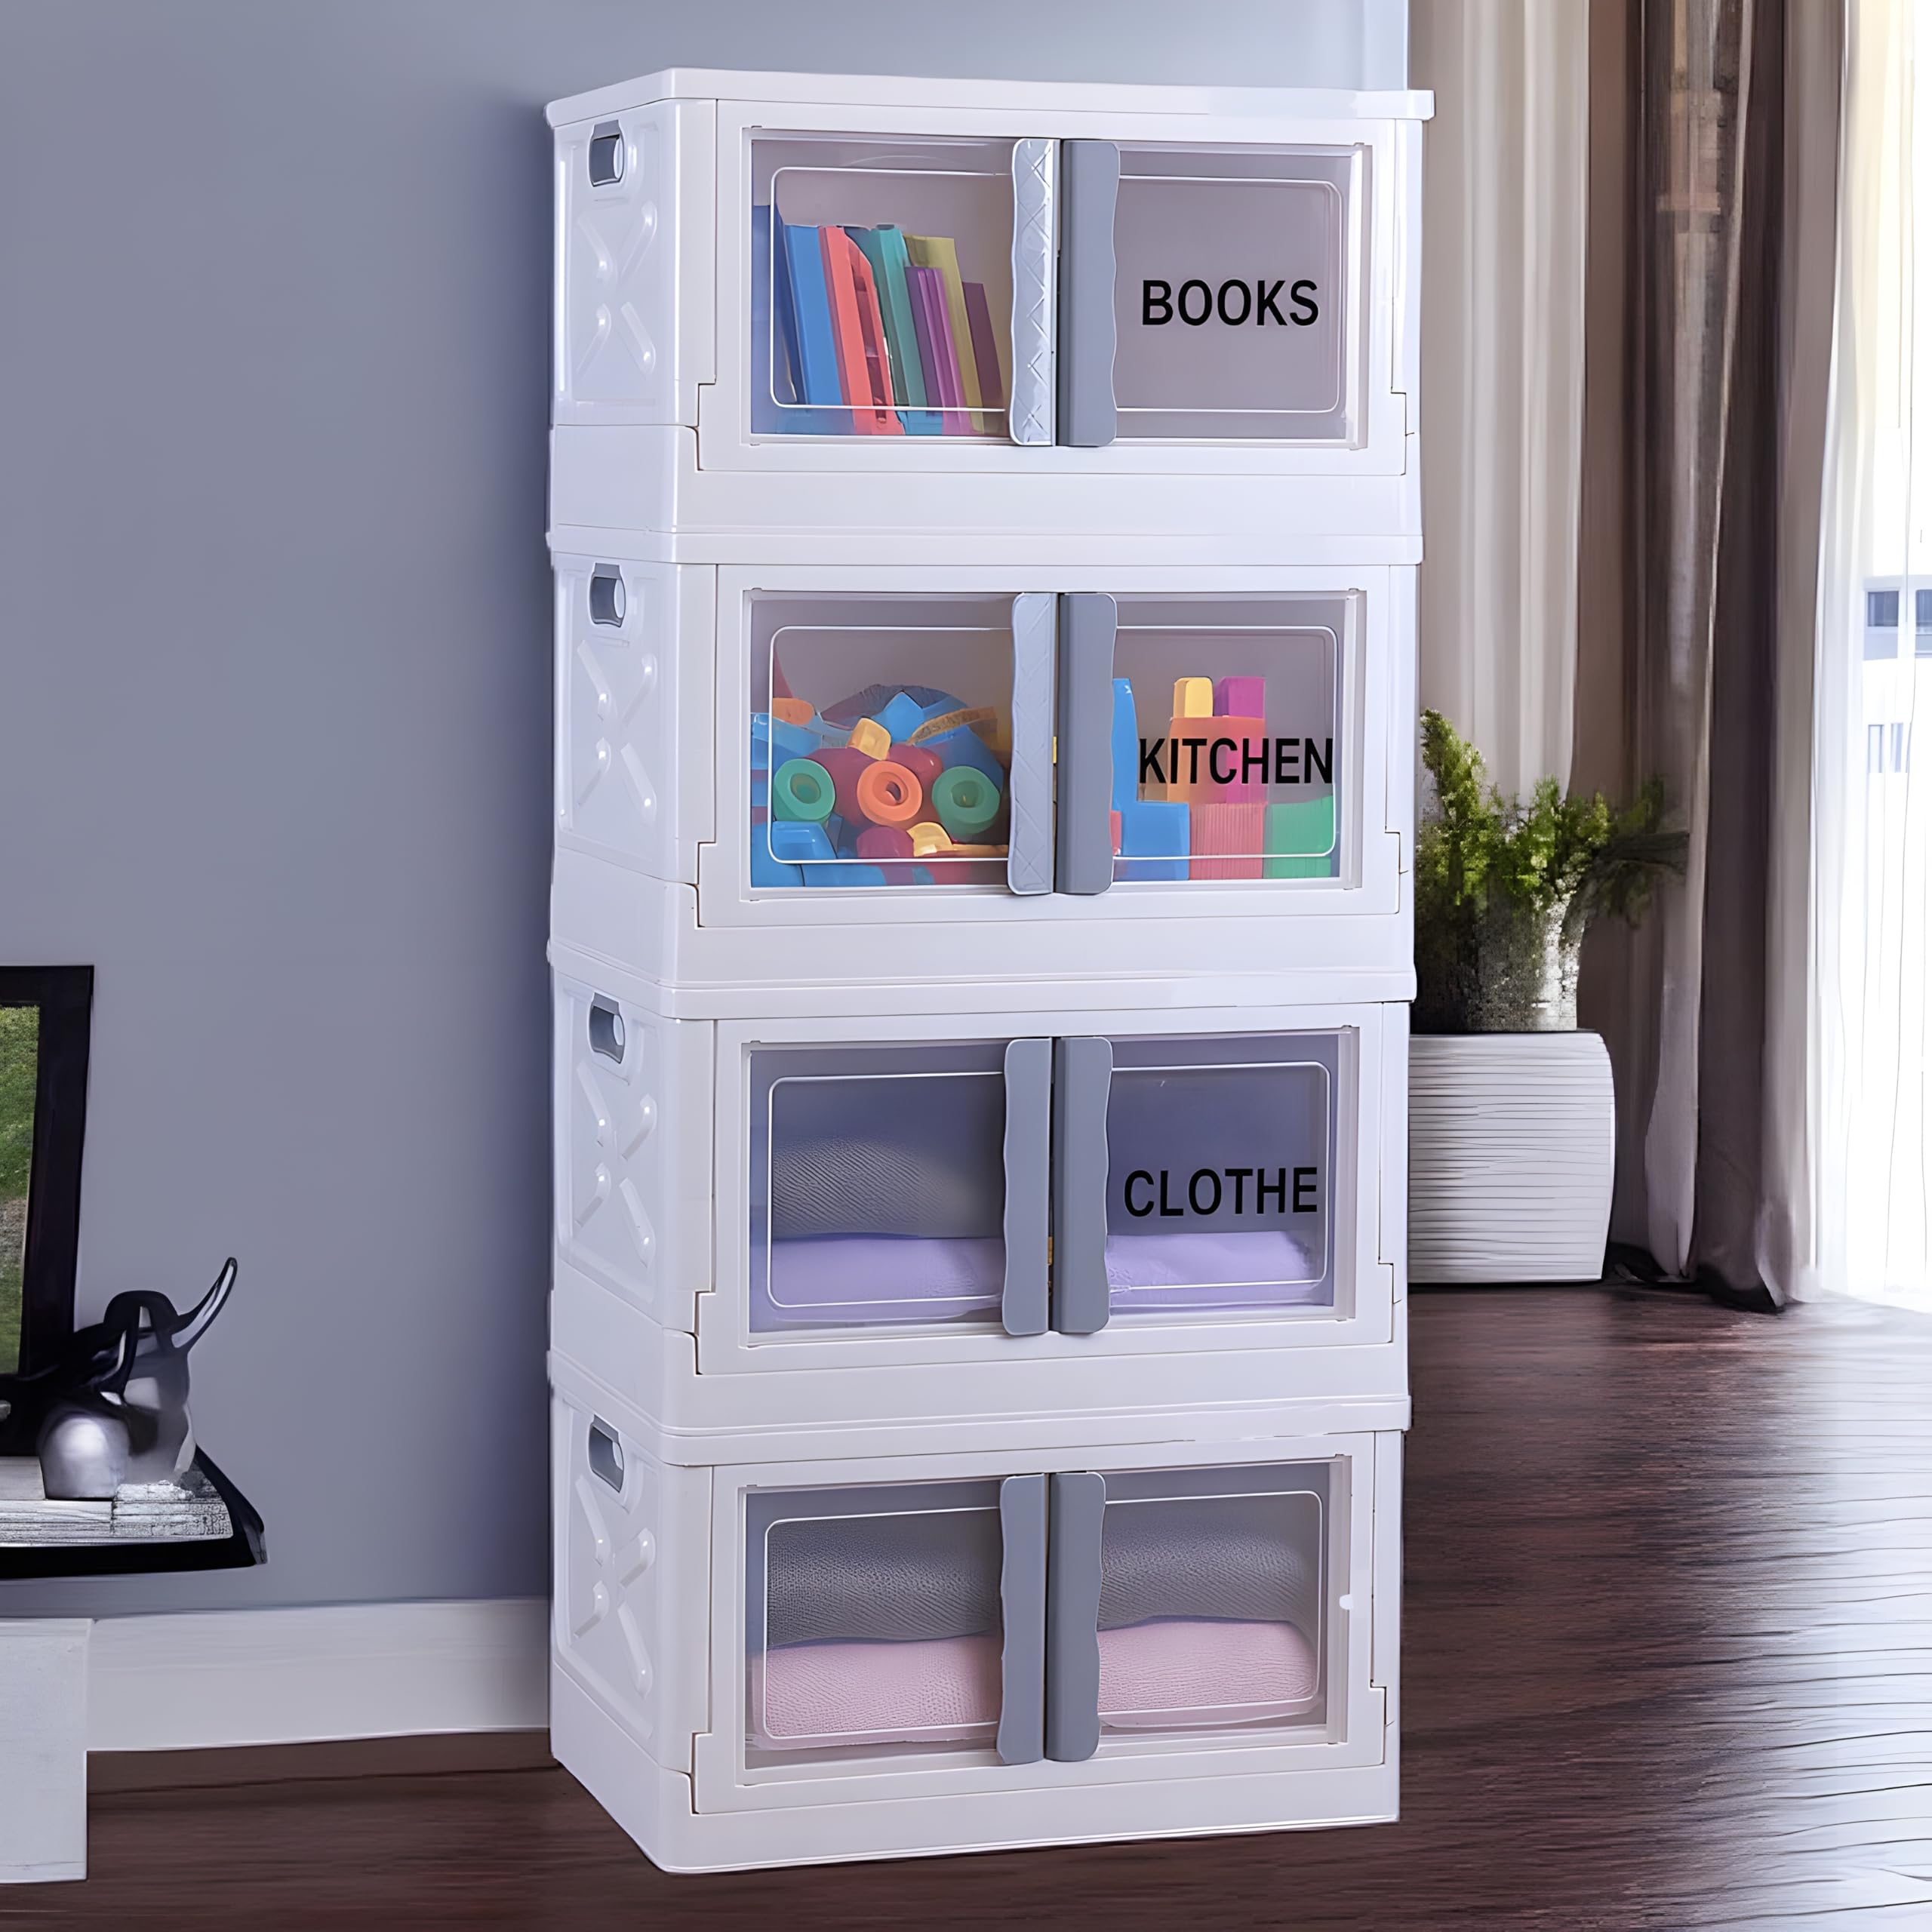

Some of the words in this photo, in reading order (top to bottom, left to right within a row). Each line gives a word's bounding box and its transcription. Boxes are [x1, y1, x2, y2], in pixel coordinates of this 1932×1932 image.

[1142, 279, 1318, 325] BOOKS
[1139, 738, 1333, 784] KITCHEN
[1124, 1167, 1318, 1217] CLOTHE
